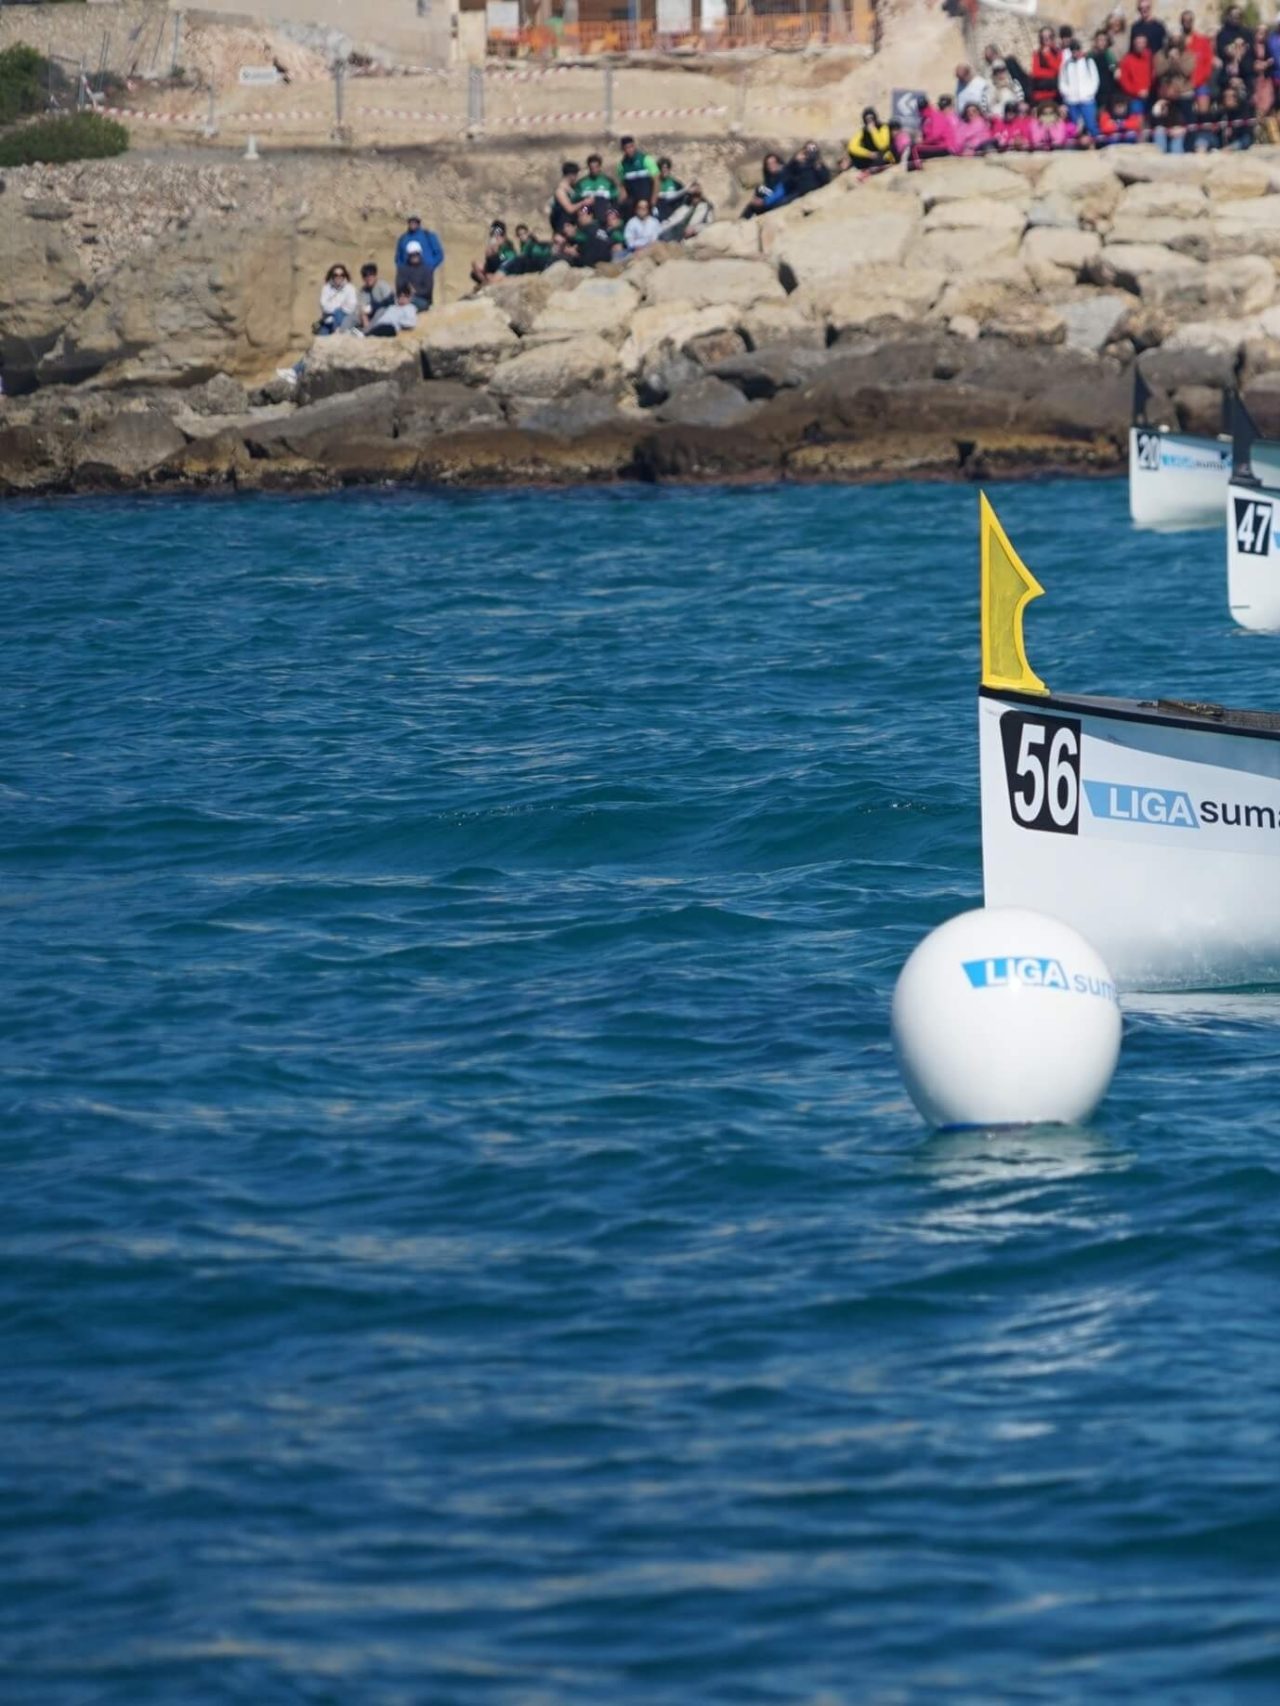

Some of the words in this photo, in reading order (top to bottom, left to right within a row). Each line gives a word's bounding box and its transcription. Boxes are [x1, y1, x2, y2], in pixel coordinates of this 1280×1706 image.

[1237, 502, 1272, 553] 47
[1013, 722, 1079, 827] 56
[1109, 787, 1194, 826] LIGA
[986, 957, 1070, 990] LIGA
[1073, 974, 1117, 1001] sum
